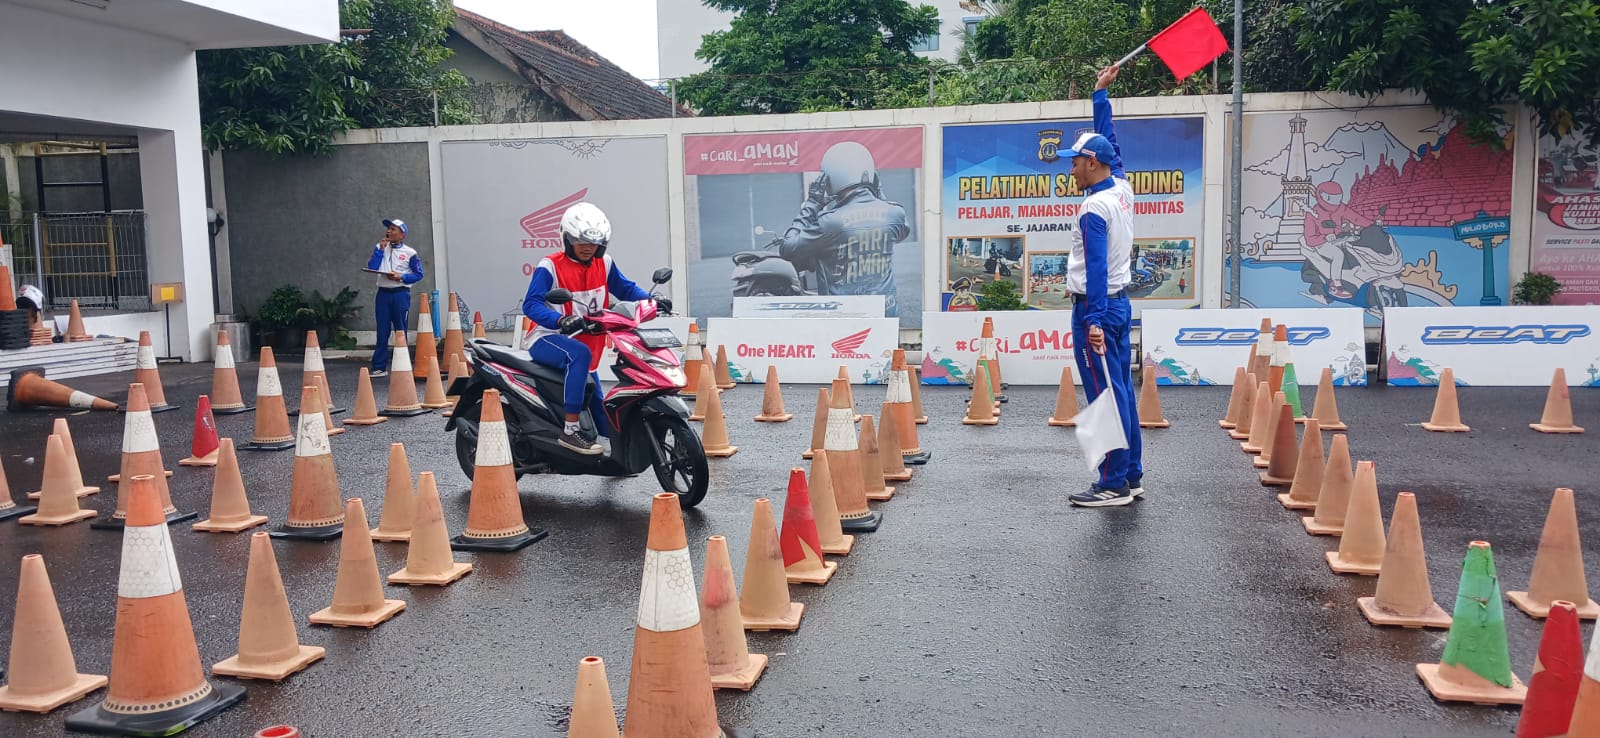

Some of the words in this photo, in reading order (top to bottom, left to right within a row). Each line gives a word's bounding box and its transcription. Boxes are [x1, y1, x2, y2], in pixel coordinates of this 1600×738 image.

[959, 173, 1050, 200] PELATIHAN
[1551, 195, 1600, 203] AHAS
[958, 207, 1014, 220] PELAJAR,
[1132, 201, 1185, 214] MUNITAS
[1006, 224, 1024, 233] SE-
[1025, 223, 1072, 232] JAJARAN
[521, 239, 562, 248] HON
[847, 253, 890, 284] AMAN
[588, 297, 598, 312] 4
[1176, 329, 1329, 343] BeT
[737, 343, 765, 357] One
[767, 344, 816, 358] HEART.
